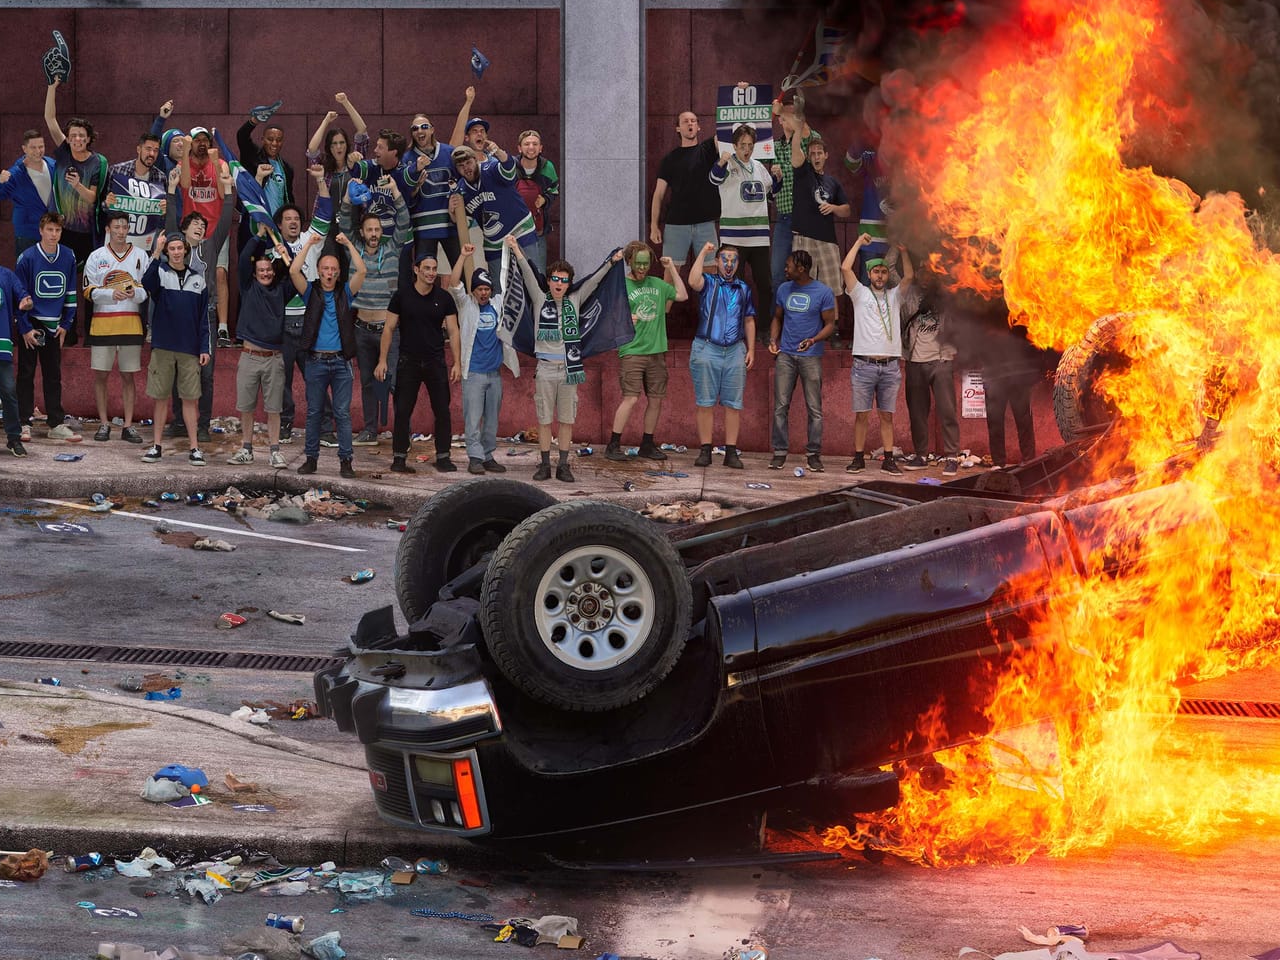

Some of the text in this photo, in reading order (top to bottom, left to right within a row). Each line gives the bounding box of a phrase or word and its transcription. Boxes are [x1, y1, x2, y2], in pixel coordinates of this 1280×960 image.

[733, 86, 756, 105] GO
[720, 107, 770, 121] CANUCKS
[128, 178, 150, 198] GO
[114, 197, 161, 213] CANUCKS
[128, 214, 148, 235] GO
[627, 286, 659, 303] VANCOUVER
